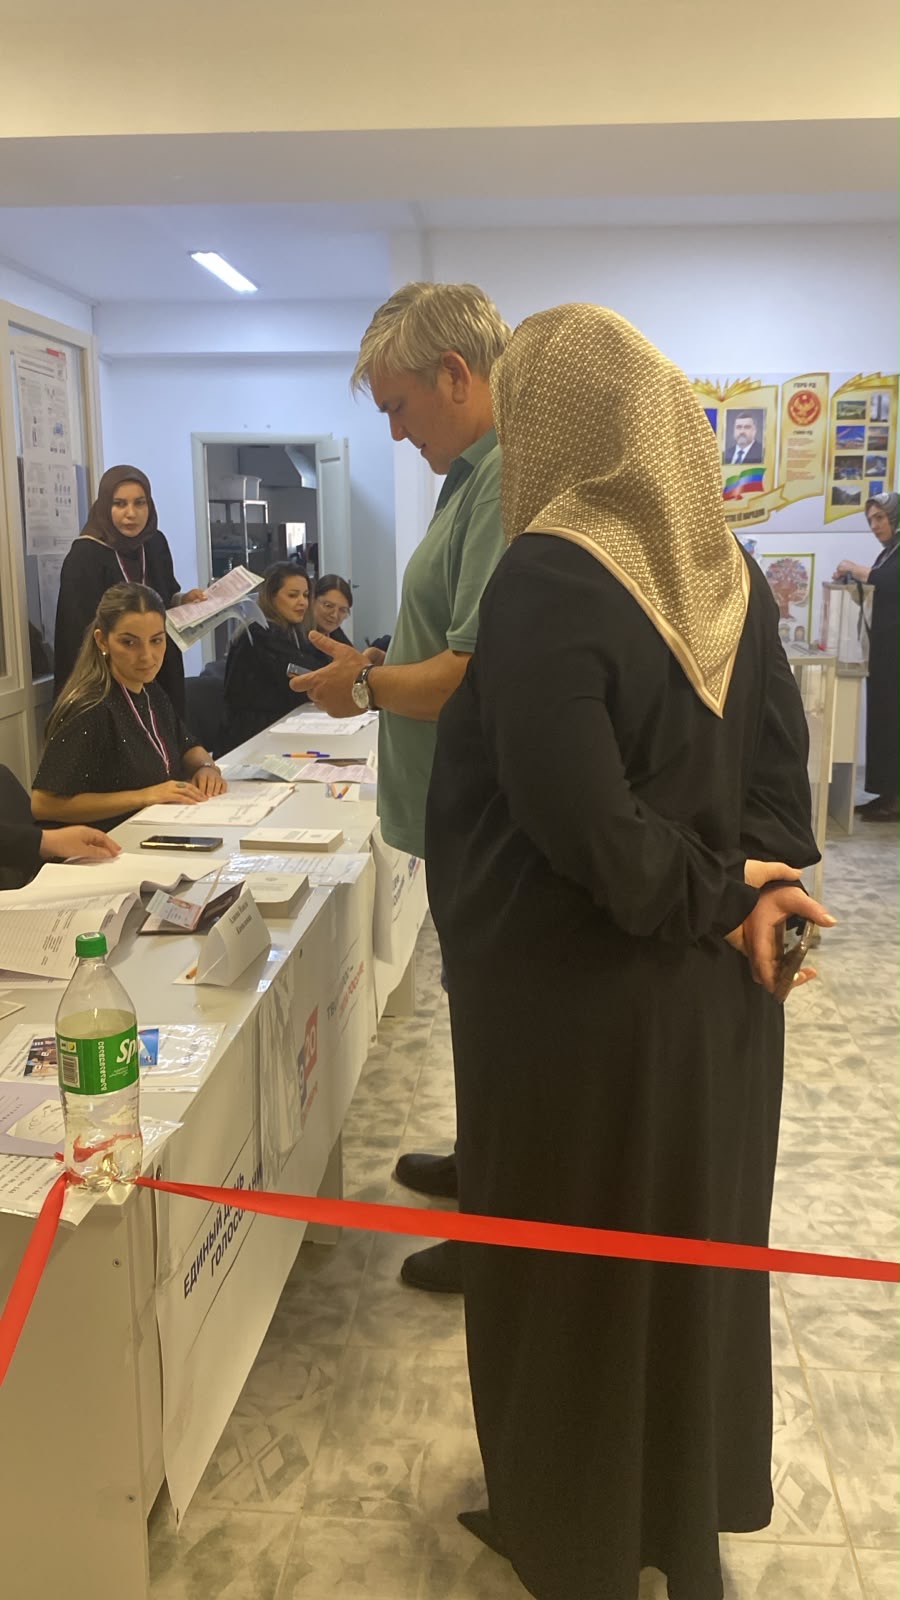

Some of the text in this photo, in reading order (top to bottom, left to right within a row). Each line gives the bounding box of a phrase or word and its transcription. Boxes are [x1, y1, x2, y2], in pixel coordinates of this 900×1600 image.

[184, 1172, 245, 1300] ЕДИНЫЙ ДНЬ
[211, 1162, 263, 1277] ГОЛОСОНИ
